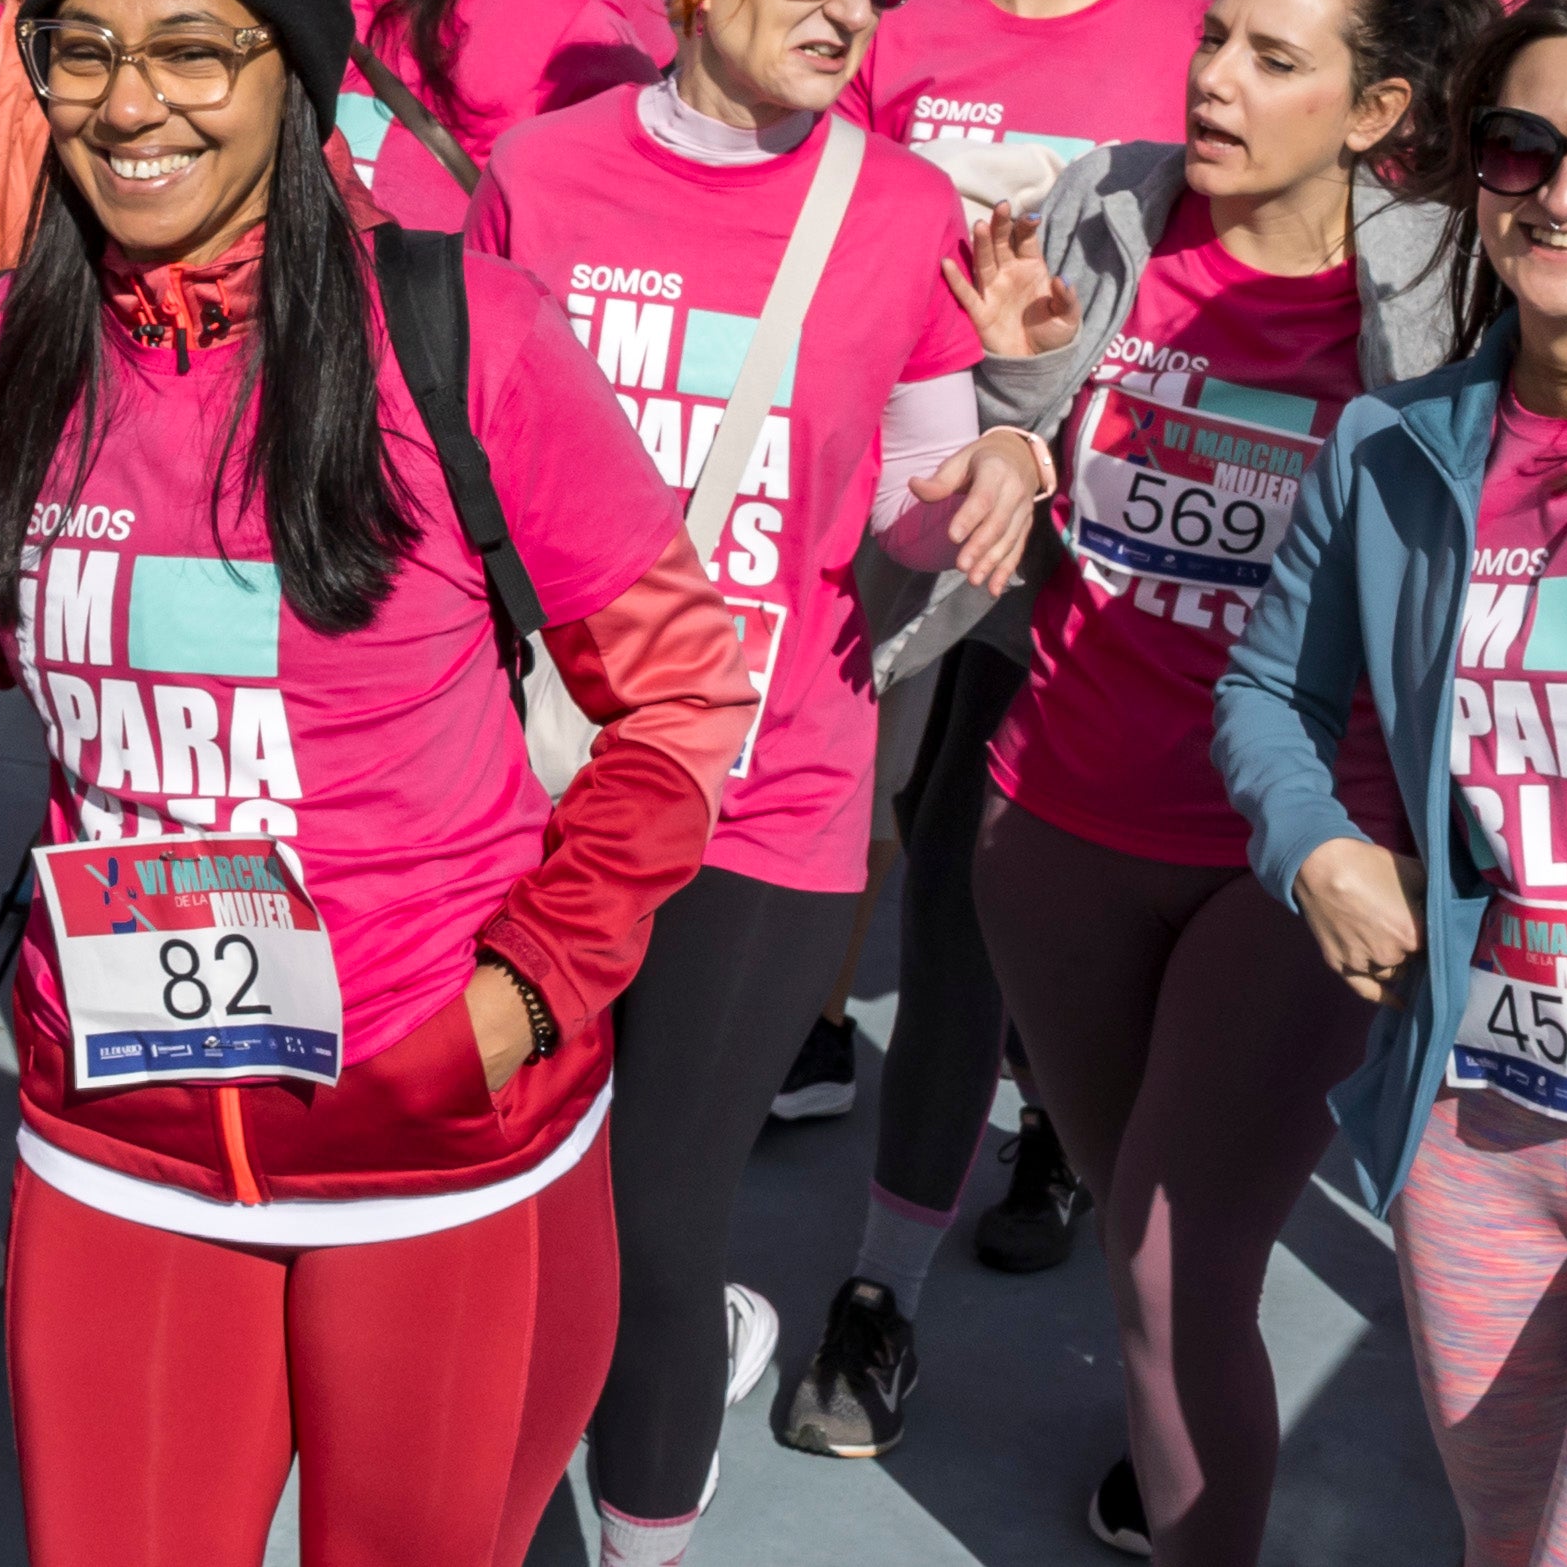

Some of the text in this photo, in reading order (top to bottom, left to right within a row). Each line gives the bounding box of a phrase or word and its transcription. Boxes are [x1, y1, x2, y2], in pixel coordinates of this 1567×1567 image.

[914, 96, 1003, 125] SOMOS
[570, 264, 682, 300] SOMOS
[1105, 333, 1210, 372] SOMOS
[1164, 420, 1306, 477] VI MARCHA
[1212, 463, 1298, 507] MUJER
[27, 502, 135, 541] SOMOS
[1123, 472, 1265, 555] 569
[1472, 547, 1549, 576] MOS
[46, 672, 303, 799] PARA
[134, 855, 287, 895] VI MARCHA
[175, 892, 295, 930] DE LA MUJER
[159, 934, 272, 1021] 82
